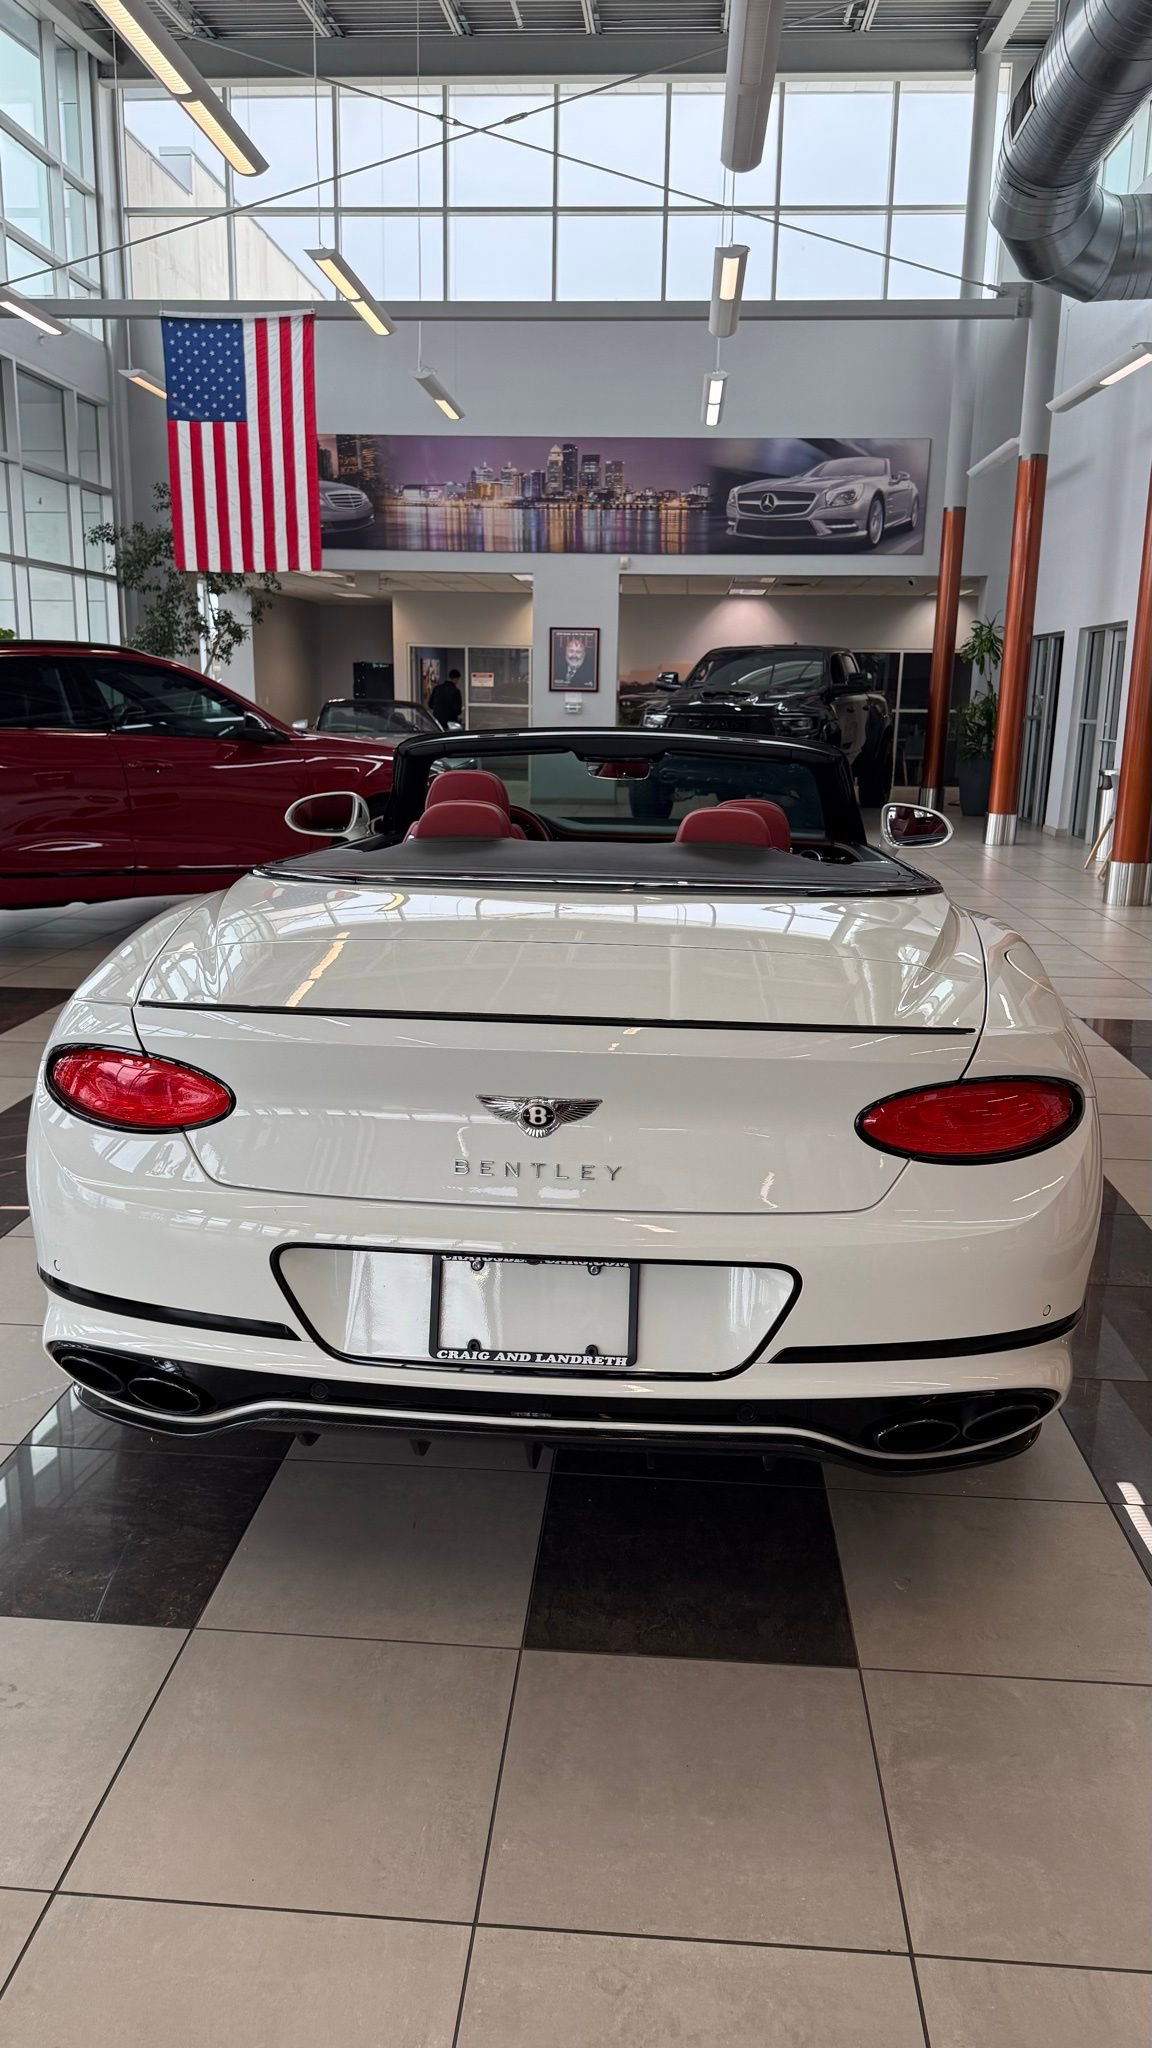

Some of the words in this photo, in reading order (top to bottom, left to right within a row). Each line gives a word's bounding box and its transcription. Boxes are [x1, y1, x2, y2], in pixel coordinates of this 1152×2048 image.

[529, 1106, 547, 1125] B
[454, 1159, 622, 1181] BENTLEY
[436, 1350, 491, 1360] CRAIG
[494, 1352, 532, 1363] AND
[535, 1353, 629, 1367] LANDRETH
